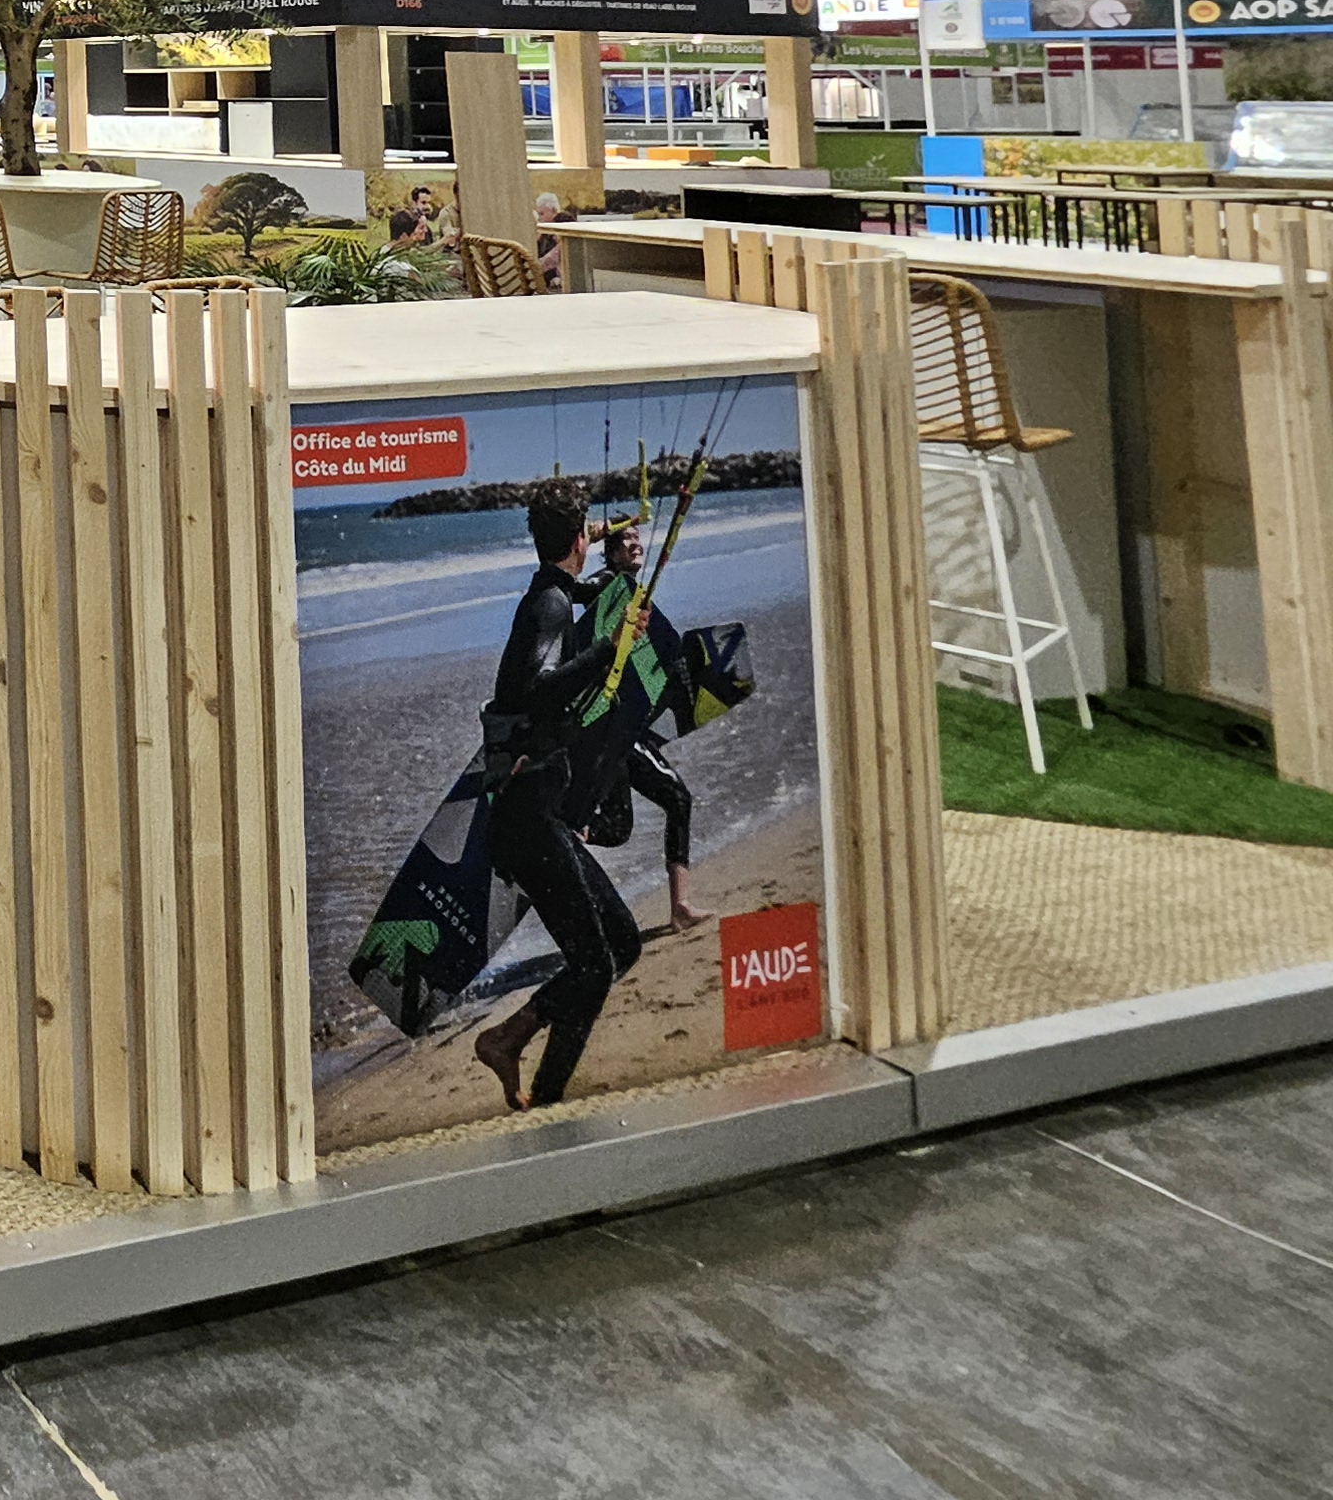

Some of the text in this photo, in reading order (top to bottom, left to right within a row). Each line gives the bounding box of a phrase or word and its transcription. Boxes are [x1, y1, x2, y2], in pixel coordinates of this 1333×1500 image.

[1230, 0, 1299, 20] AOP
[292, 427, 458, 451] Office de tourisme
[294, 455, 407, 478] Côte du Midi
[730, 941, 812, 990] L'AUDE
